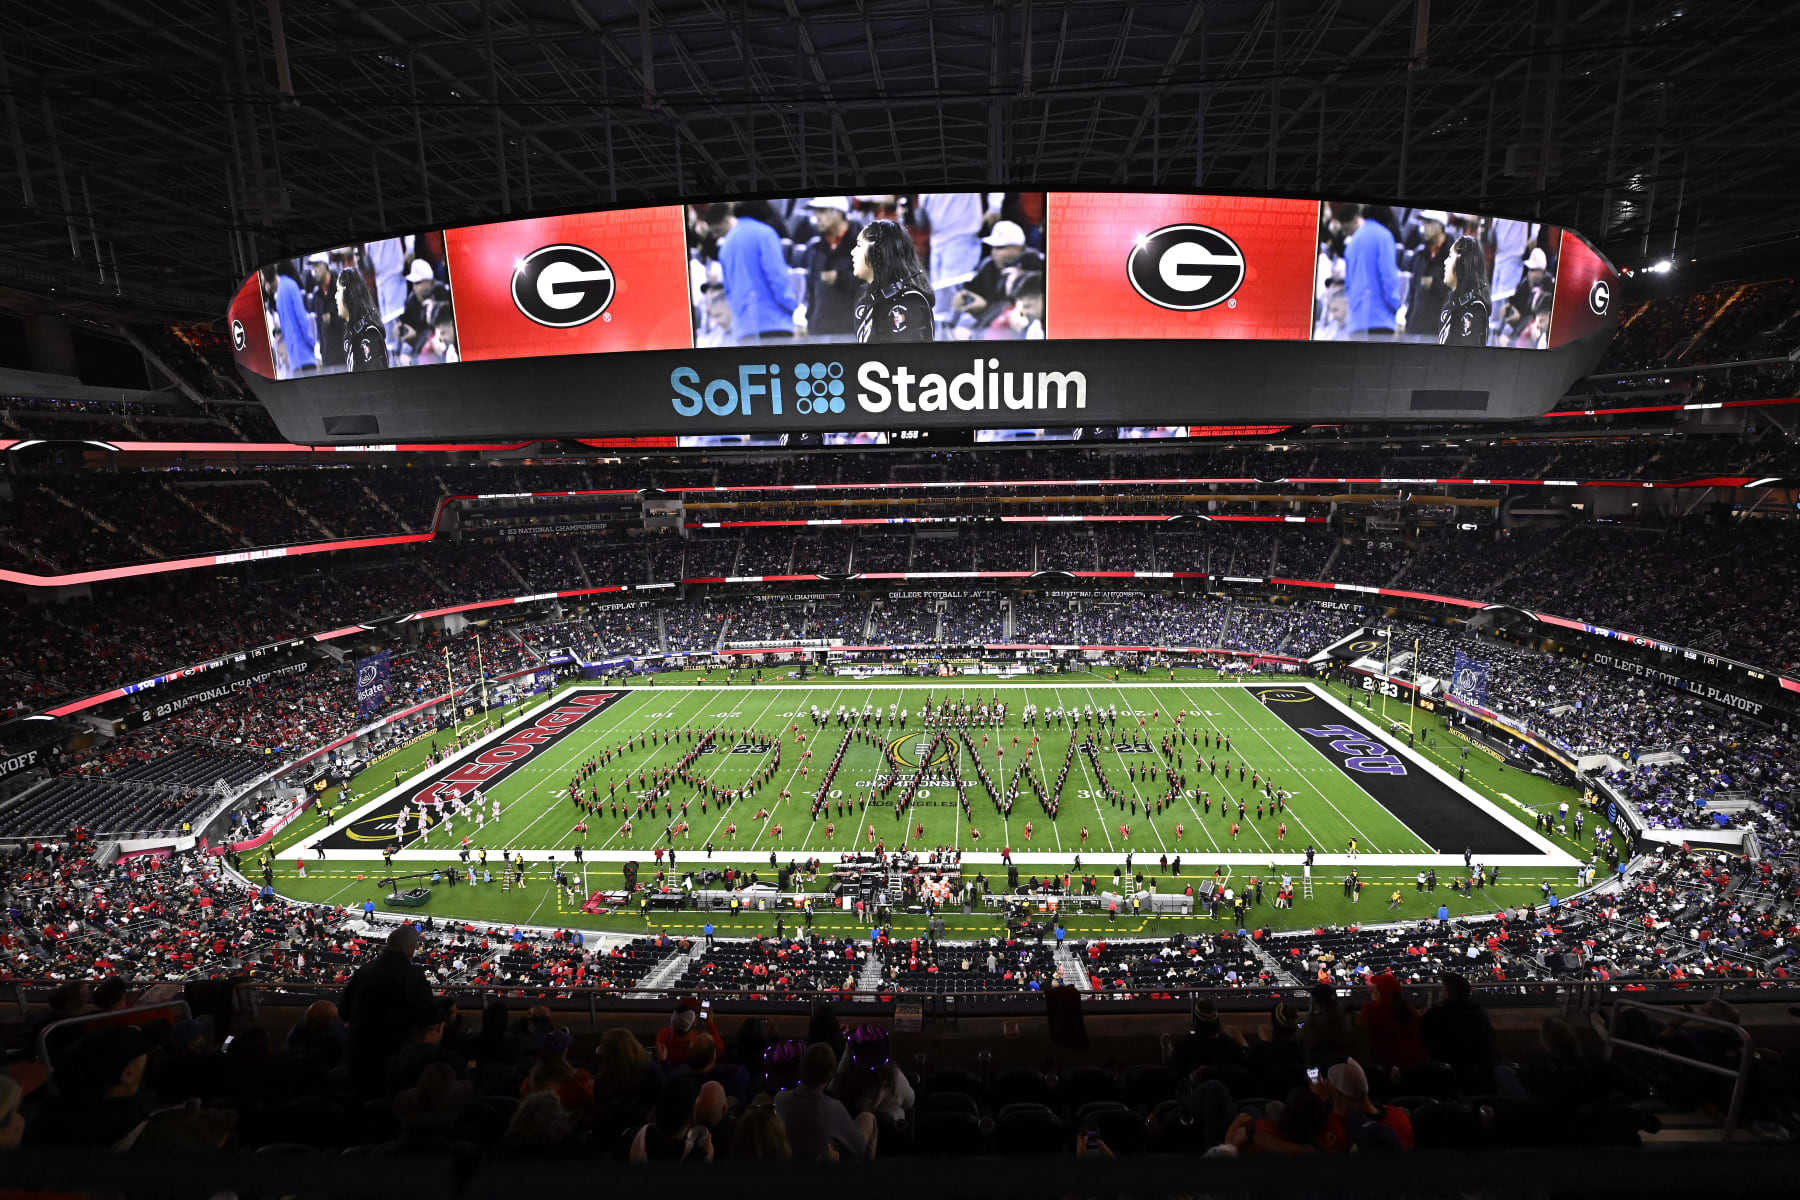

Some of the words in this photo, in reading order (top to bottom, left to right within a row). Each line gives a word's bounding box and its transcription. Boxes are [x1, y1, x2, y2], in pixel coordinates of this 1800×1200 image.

[670, 363, 783, 417] SoFi
[857, 358, 1087, 413] Stadium
[518, 526, 553, 535] NATIONAL
[555, 523, 607, 533] CHAMPIONSHIP
[1707, 687, 1763, 715] PLAYOFF
[401, 728, 438, 749] CHAMPIONSHIP
[412, 691, 618, 804] GEORGIA
[1299, 724, 1408, 776] TCU
[1448, 727, 1471, 744] NATIONAL
[1471, 739, 1505, 763] CHAMPIONSHIP
[0, 750, 38, 777] YOFF
[1615, 814, 1631, 839] AT&T
